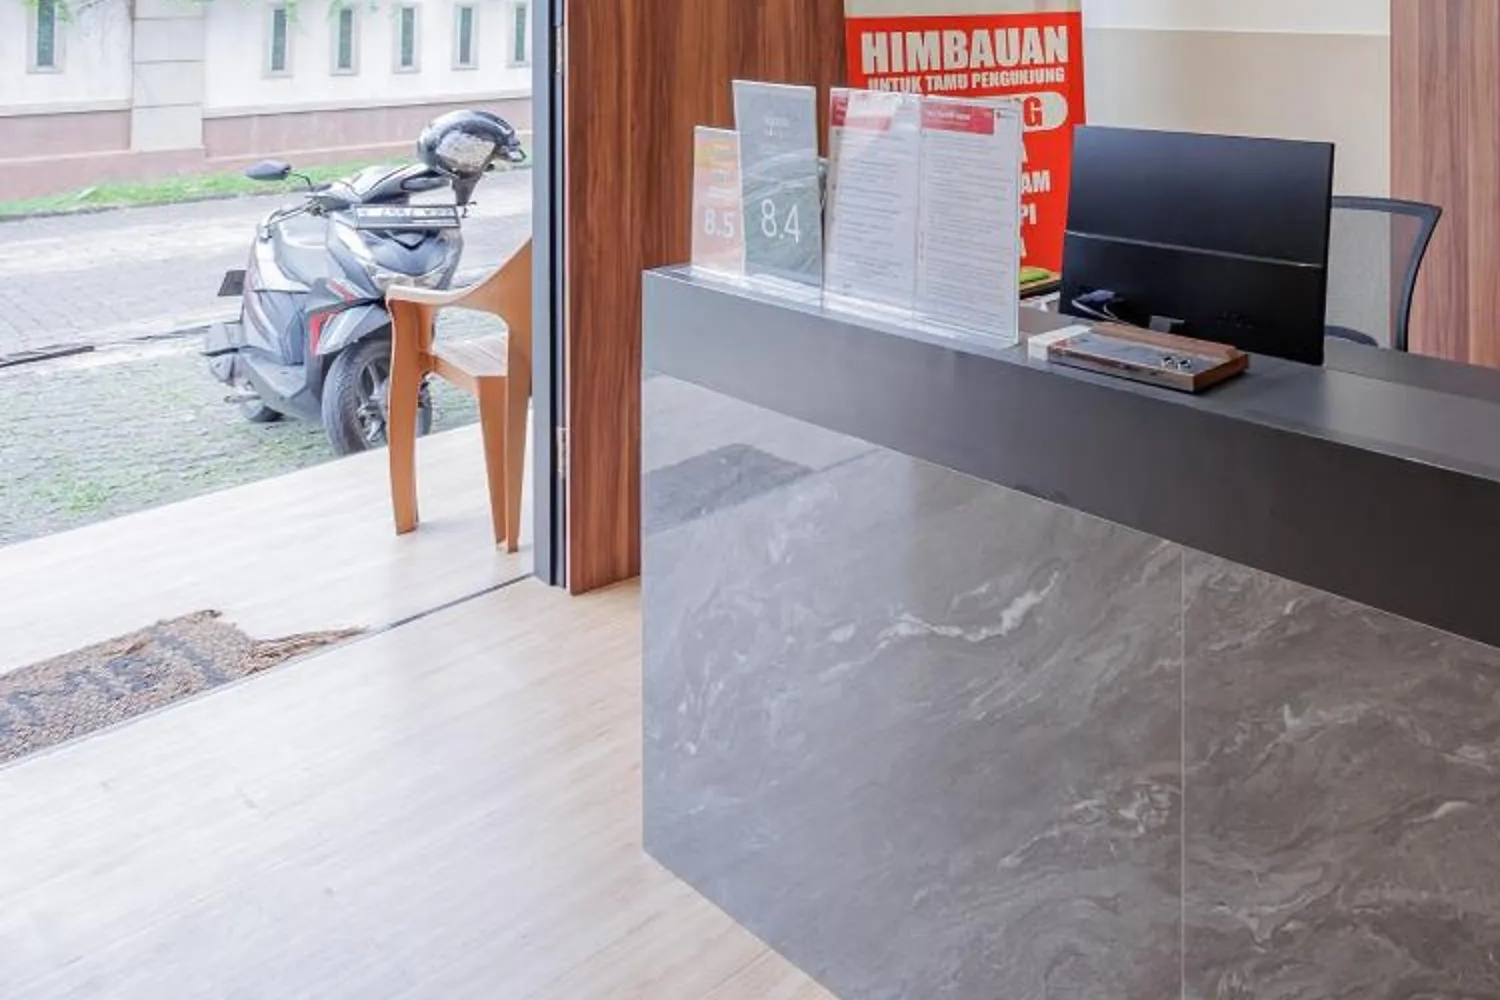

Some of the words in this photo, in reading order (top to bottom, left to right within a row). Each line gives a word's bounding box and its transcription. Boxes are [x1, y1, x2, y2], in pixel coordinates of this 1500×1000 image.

[861, 25, 1069, 74] HIMBAUAN
[868, 76, 922, 93] UNTUK
[926, 73, 967, 91] TAMU
[971, 67, 1065, 89] PENGUNJUNG
[704, 209, 735, 239] 8.5
[761, 199, 800, 243] 8.4
